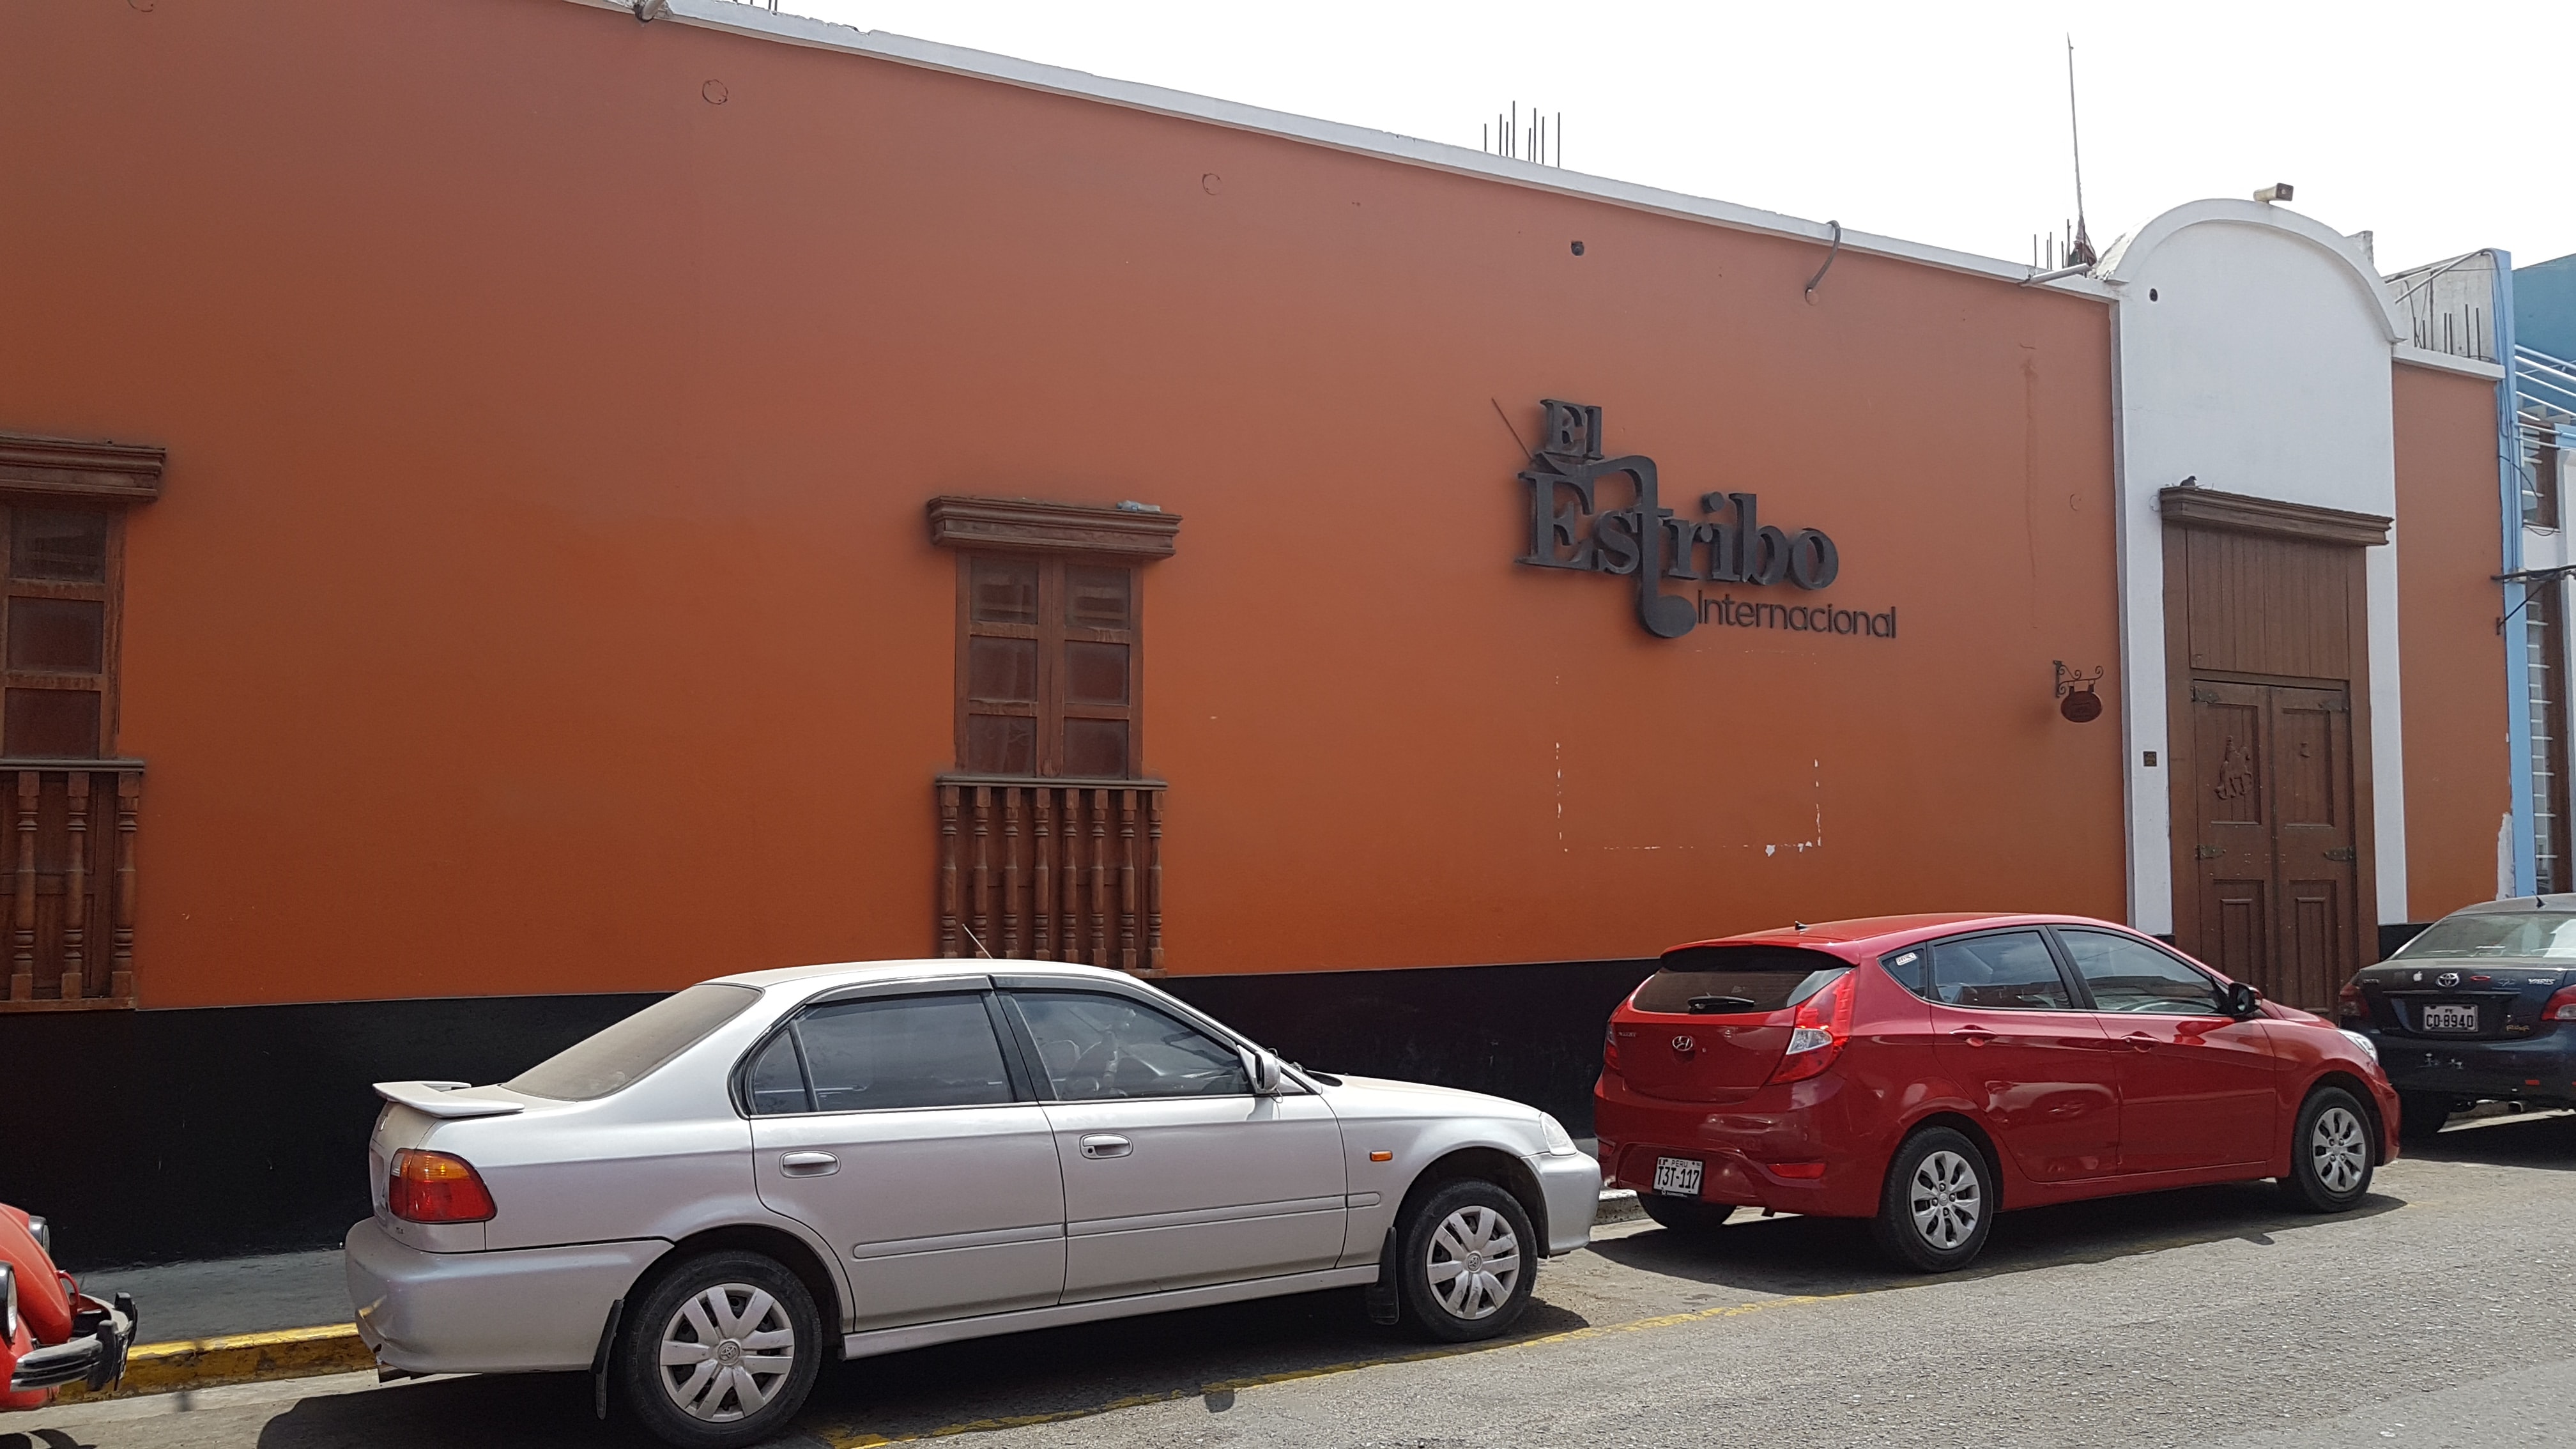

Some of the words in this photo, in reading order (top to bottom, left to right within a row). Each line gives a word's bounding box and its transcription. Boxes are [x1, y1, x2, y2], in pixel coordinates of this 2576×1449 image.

[1540, 399, 1604, 459] El
[1515, 455, 1839, 638] Estribo
[1697, 589, 1897, 638] Internacional
[1657, 1166, 1700, 1189] T3T-117
[1671, 1160, 1688, 1168] PERU
